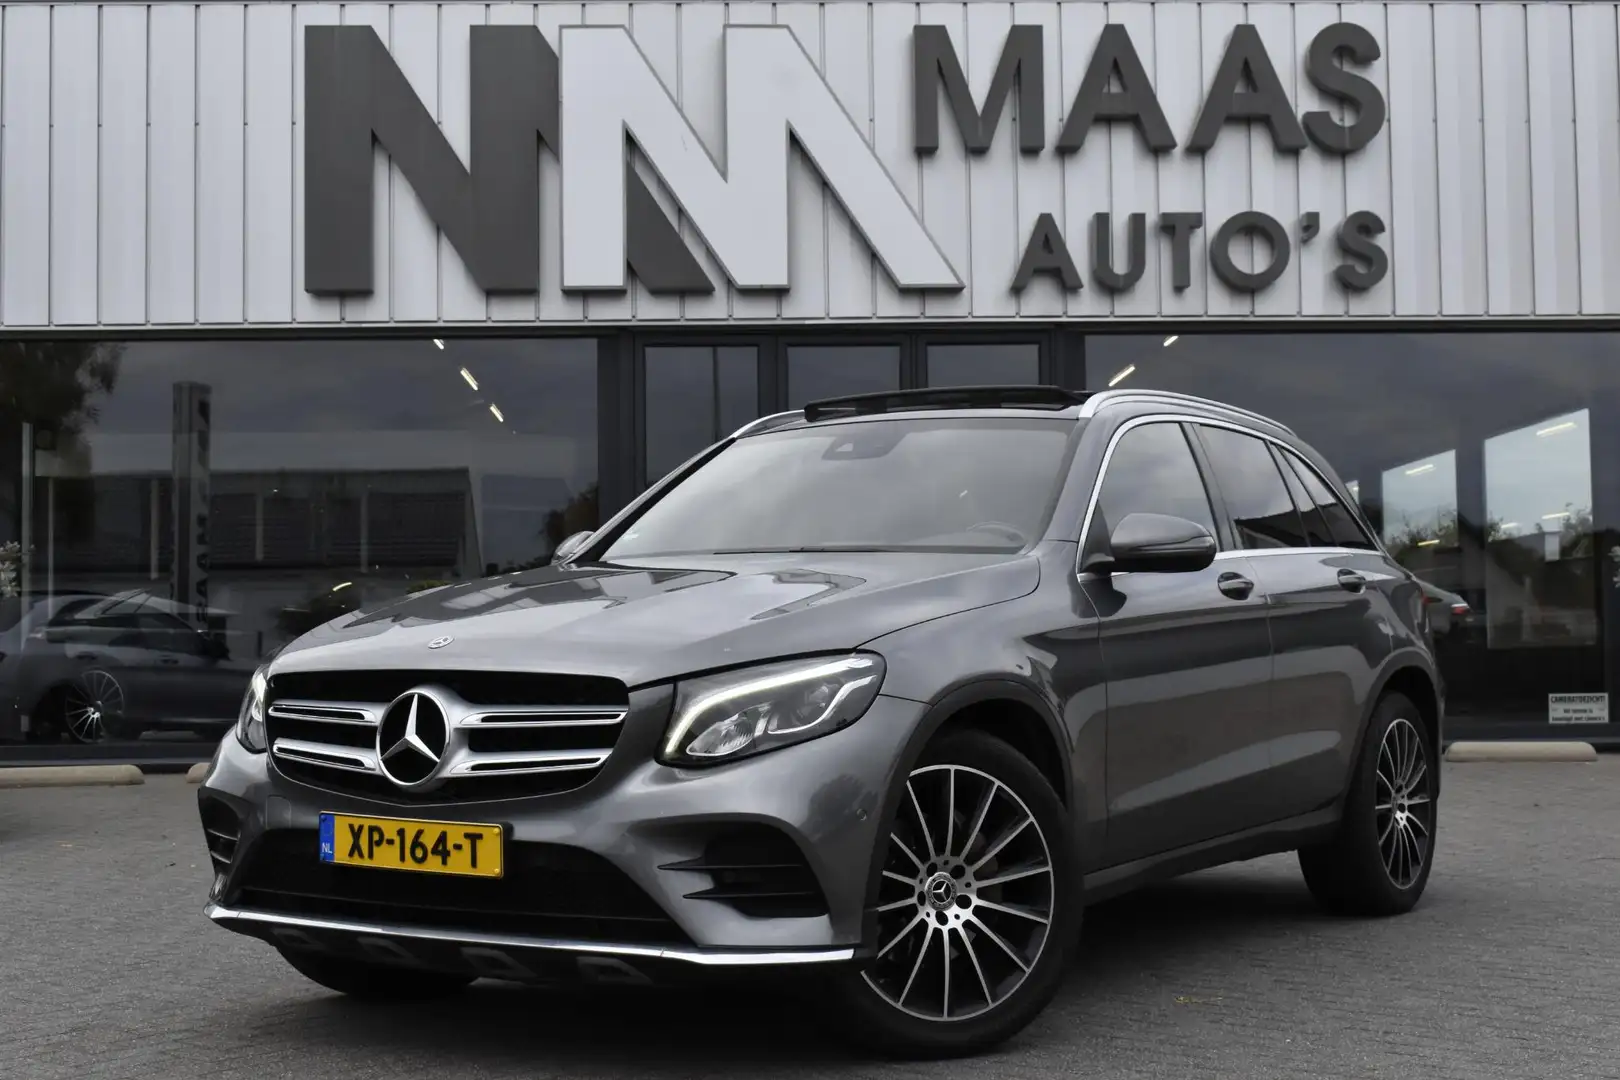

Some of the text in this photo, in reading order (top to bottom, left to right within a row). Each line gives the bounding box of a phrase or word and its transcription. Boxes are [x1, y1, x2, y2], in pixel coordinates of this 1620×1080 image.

[913, 22, 1386, 153] MAAS
[1010, 211, 1389, 292] AUTO'S
[322, 823, 484, 869] NL XP-164-T
